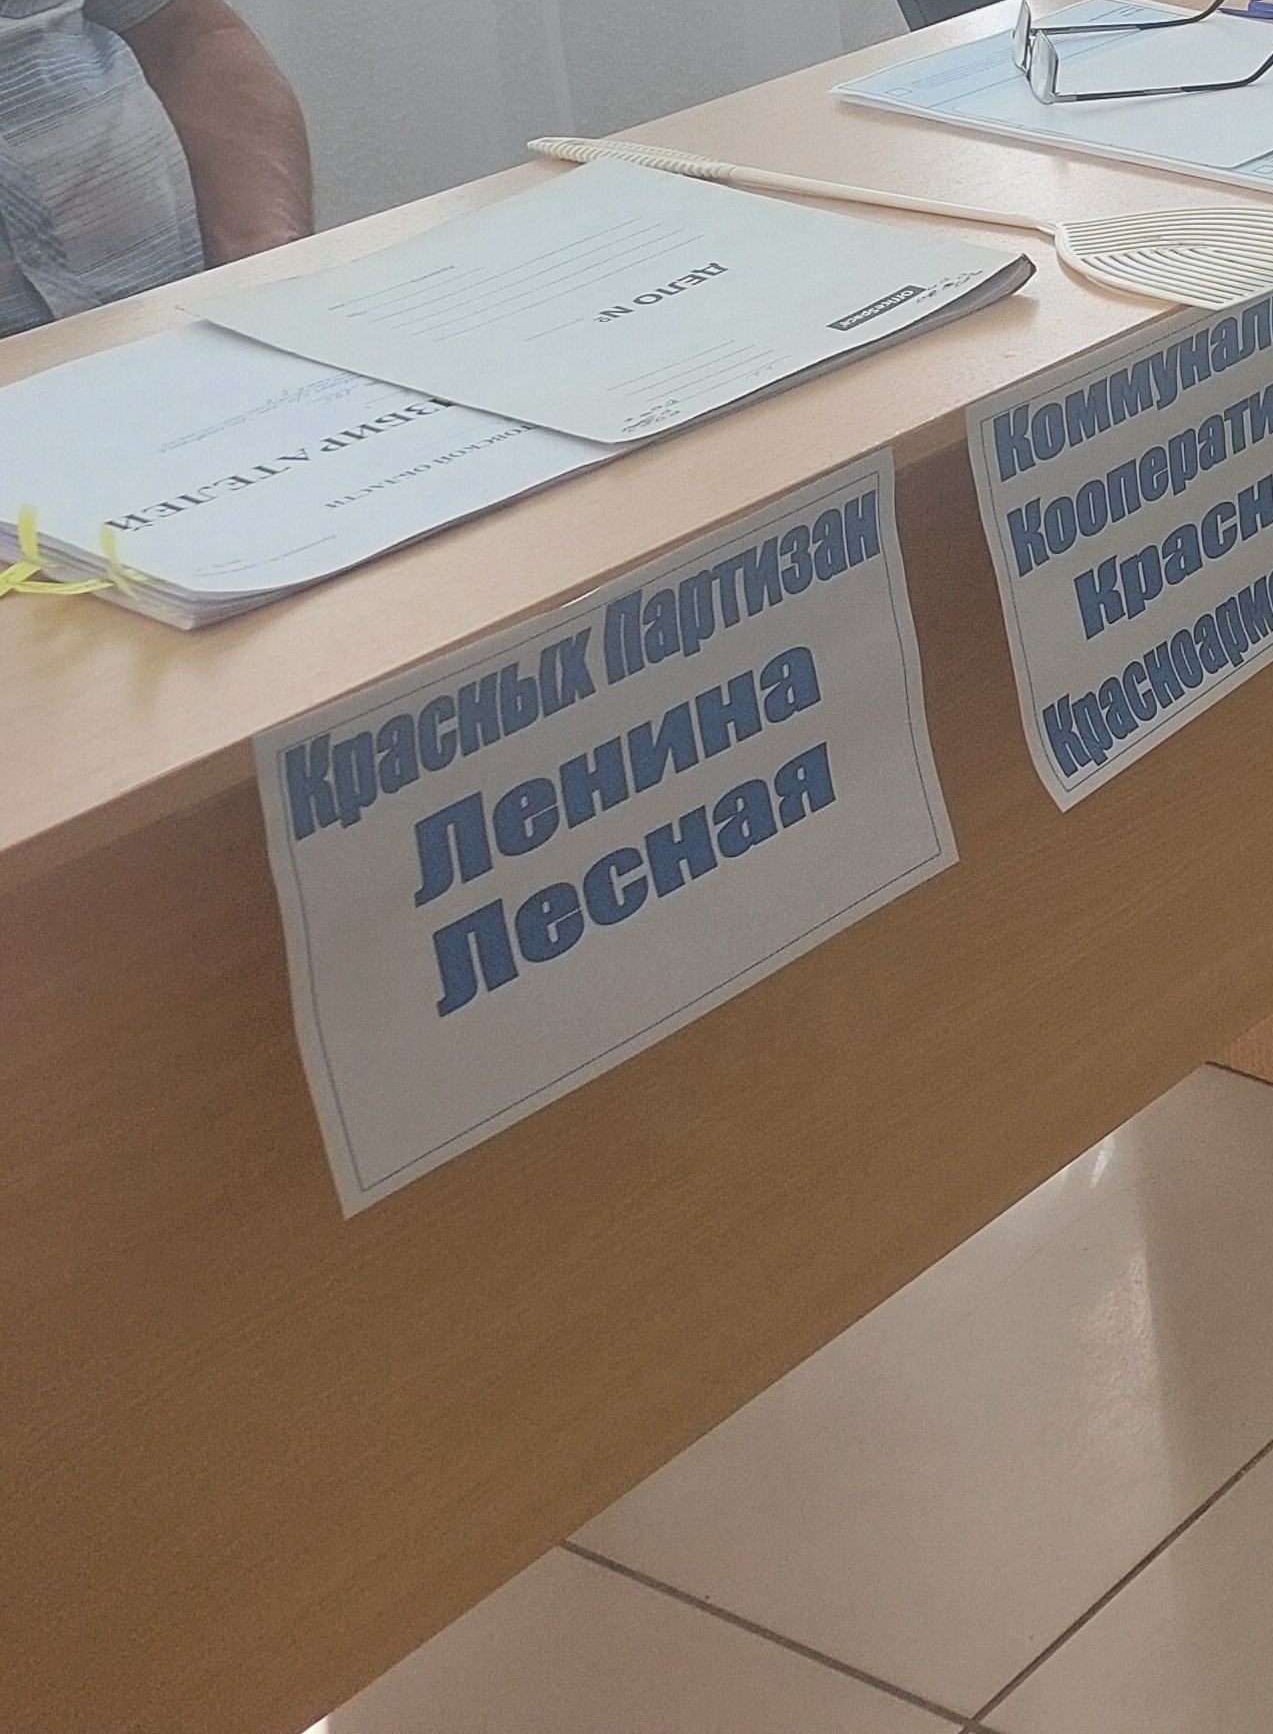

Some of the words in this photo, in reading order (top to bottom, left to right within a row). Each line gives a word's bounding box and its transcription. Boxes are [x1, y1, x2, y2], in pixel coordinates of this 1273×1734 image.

[633, 262, 729, 305] ДЕЛО
[433, 424, 537, 467] ТОВСКОЙ
[285, 627, 597, 841] Красных
[606, 489, 881, 684] Партизан
[414, 645, 822, 908] Ленина
[433, 741, 837, 1018] Лесная
